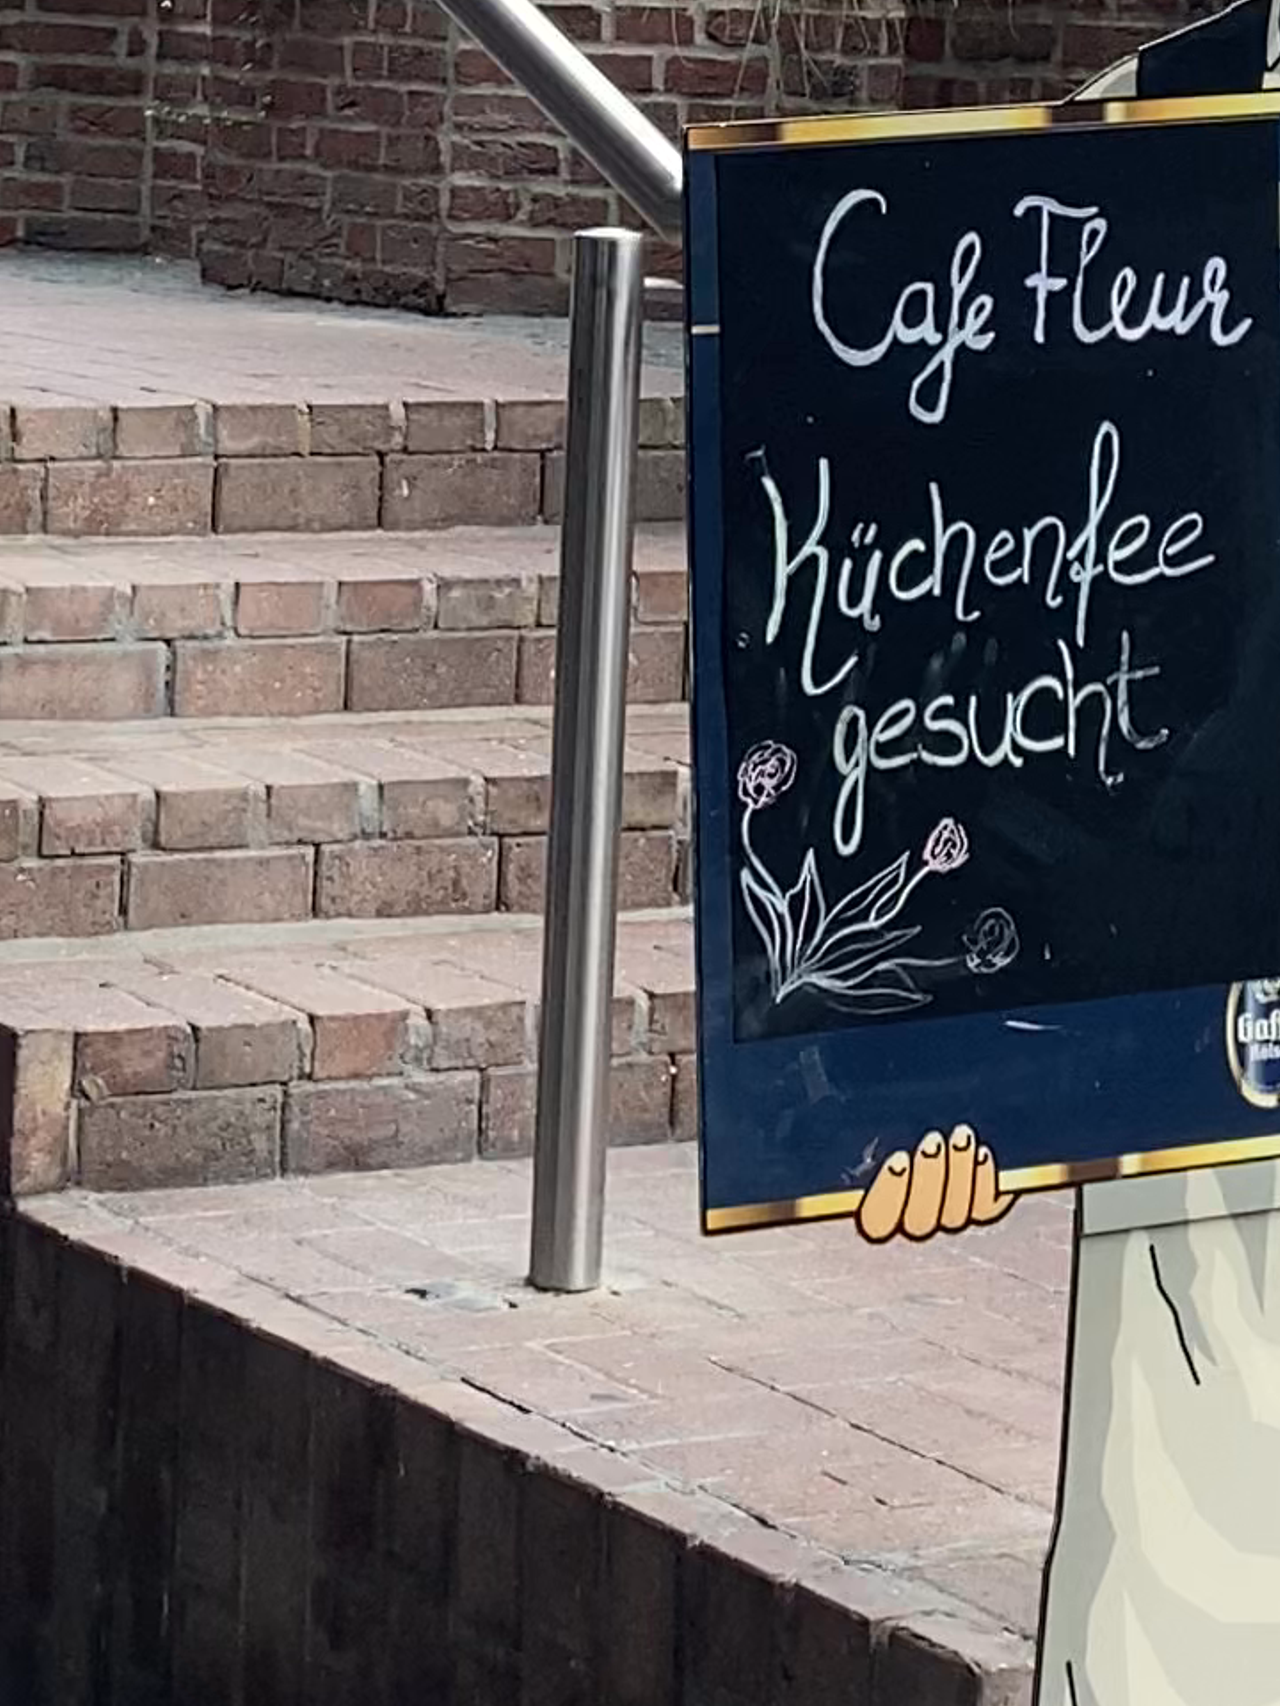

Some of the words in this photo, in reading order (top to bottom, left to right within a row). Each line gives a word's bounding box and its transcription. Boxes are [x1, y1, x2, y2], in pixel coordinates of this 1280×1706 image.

[812, 188, 995, 424] Cafe
[1013, 194, 1252, 346] Fleur
[746, 420, 1215, 696] Küchenfee
[833, 630, 1169, 857] gesucht
